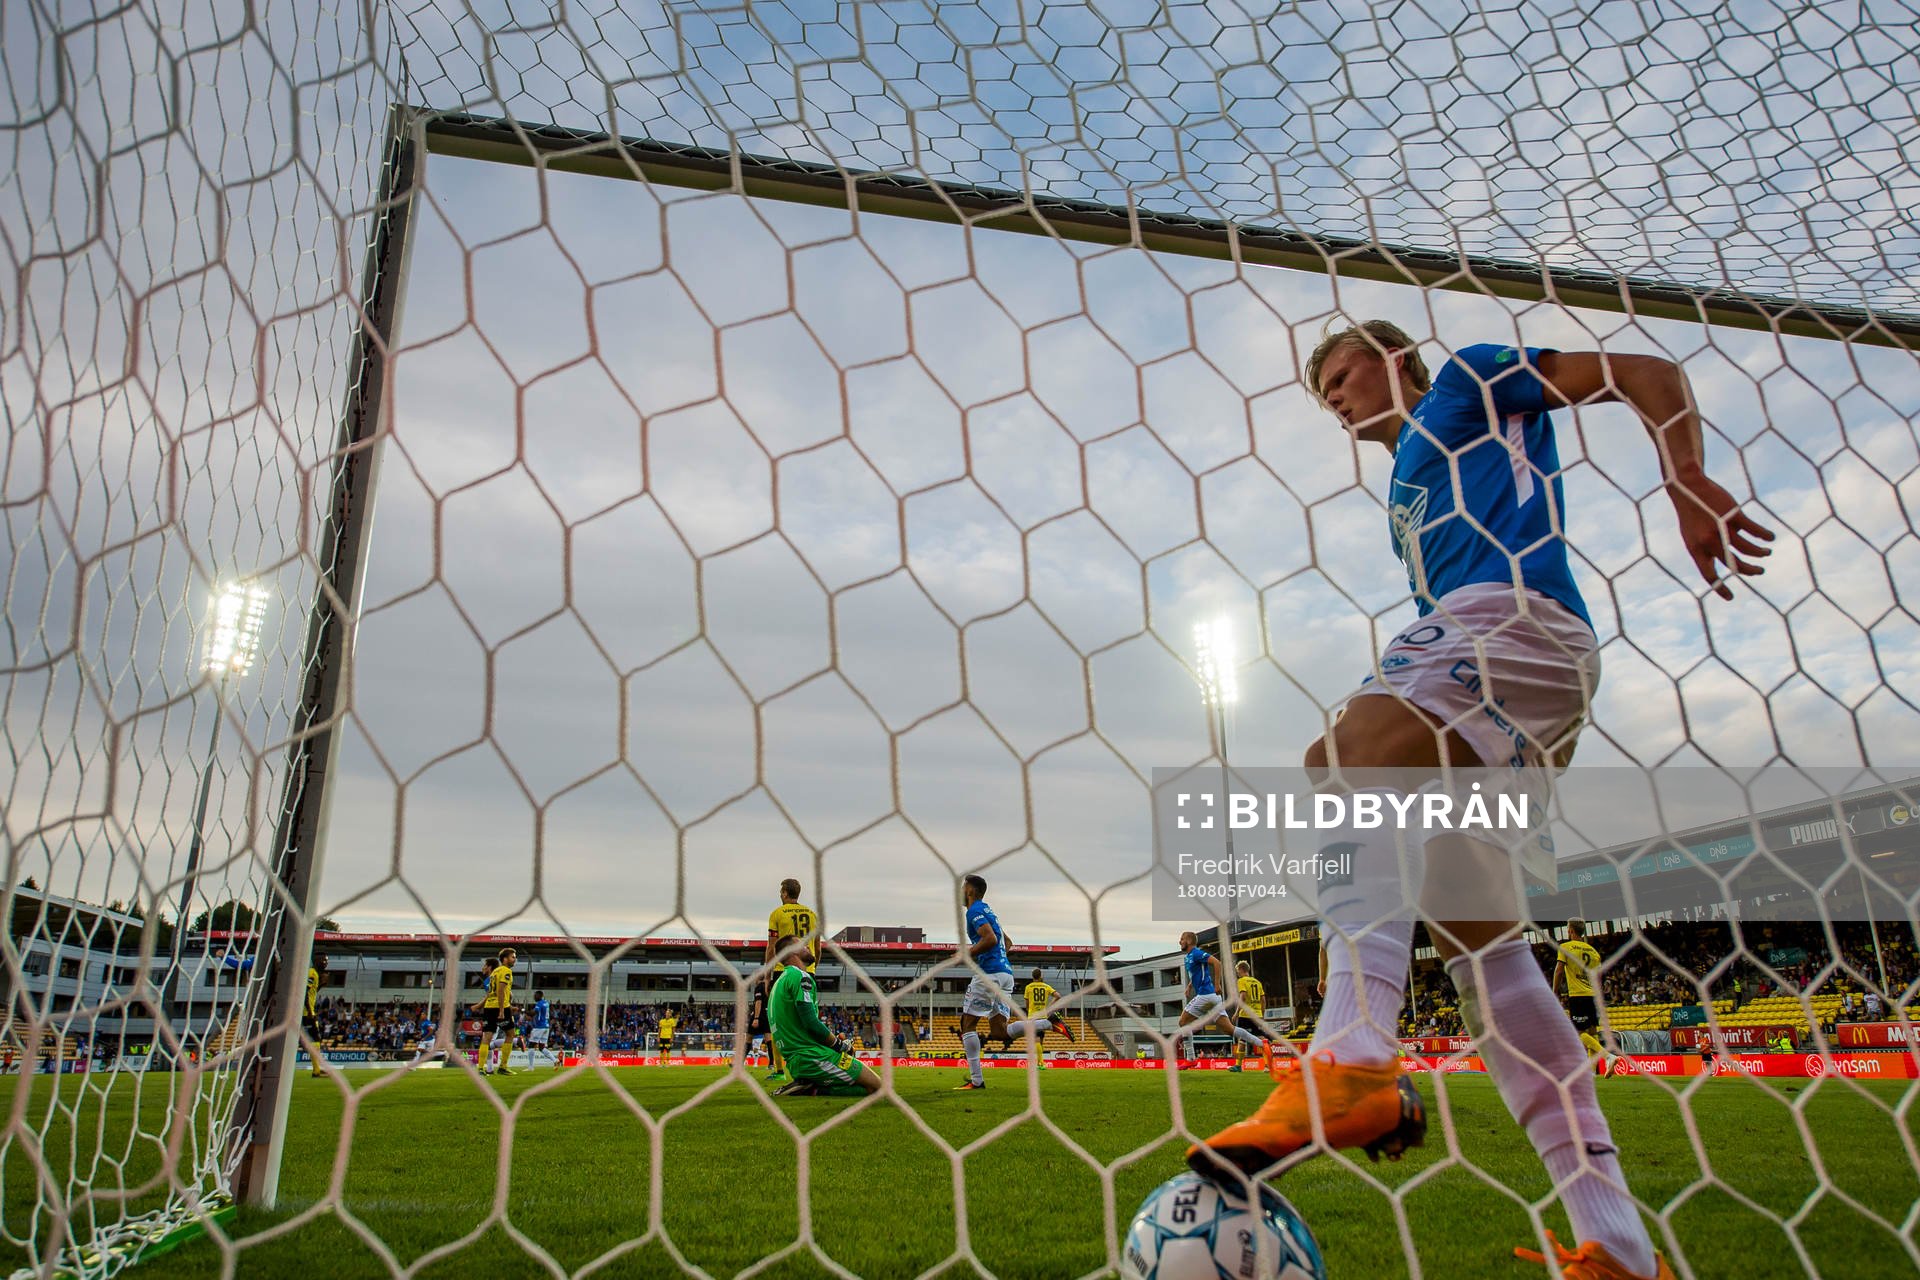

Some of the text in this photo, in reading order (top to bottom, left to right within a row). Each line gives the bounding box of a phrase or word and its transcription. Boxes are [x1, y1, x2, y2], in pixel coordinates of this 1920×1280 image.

[1789, 819, 1838, 845] PUMA
[1709, 843, 1728, 859] DNB
[1663, 852, 1681, 868] DNB
[1577, 871, 1592, 885] DNB
[791, 914, 810, 937] 13
[1033, 987, 1046, 1002] 88
[1250, 984, 1259, 1000] 11
[1673, 1009, 1689, 1022] DNB
[1743, 1030, 1752, 1043] it
[330, 1052, 366, 1060] RENHOLD
[1831, 1059, 1881, 1073] YNSAM
